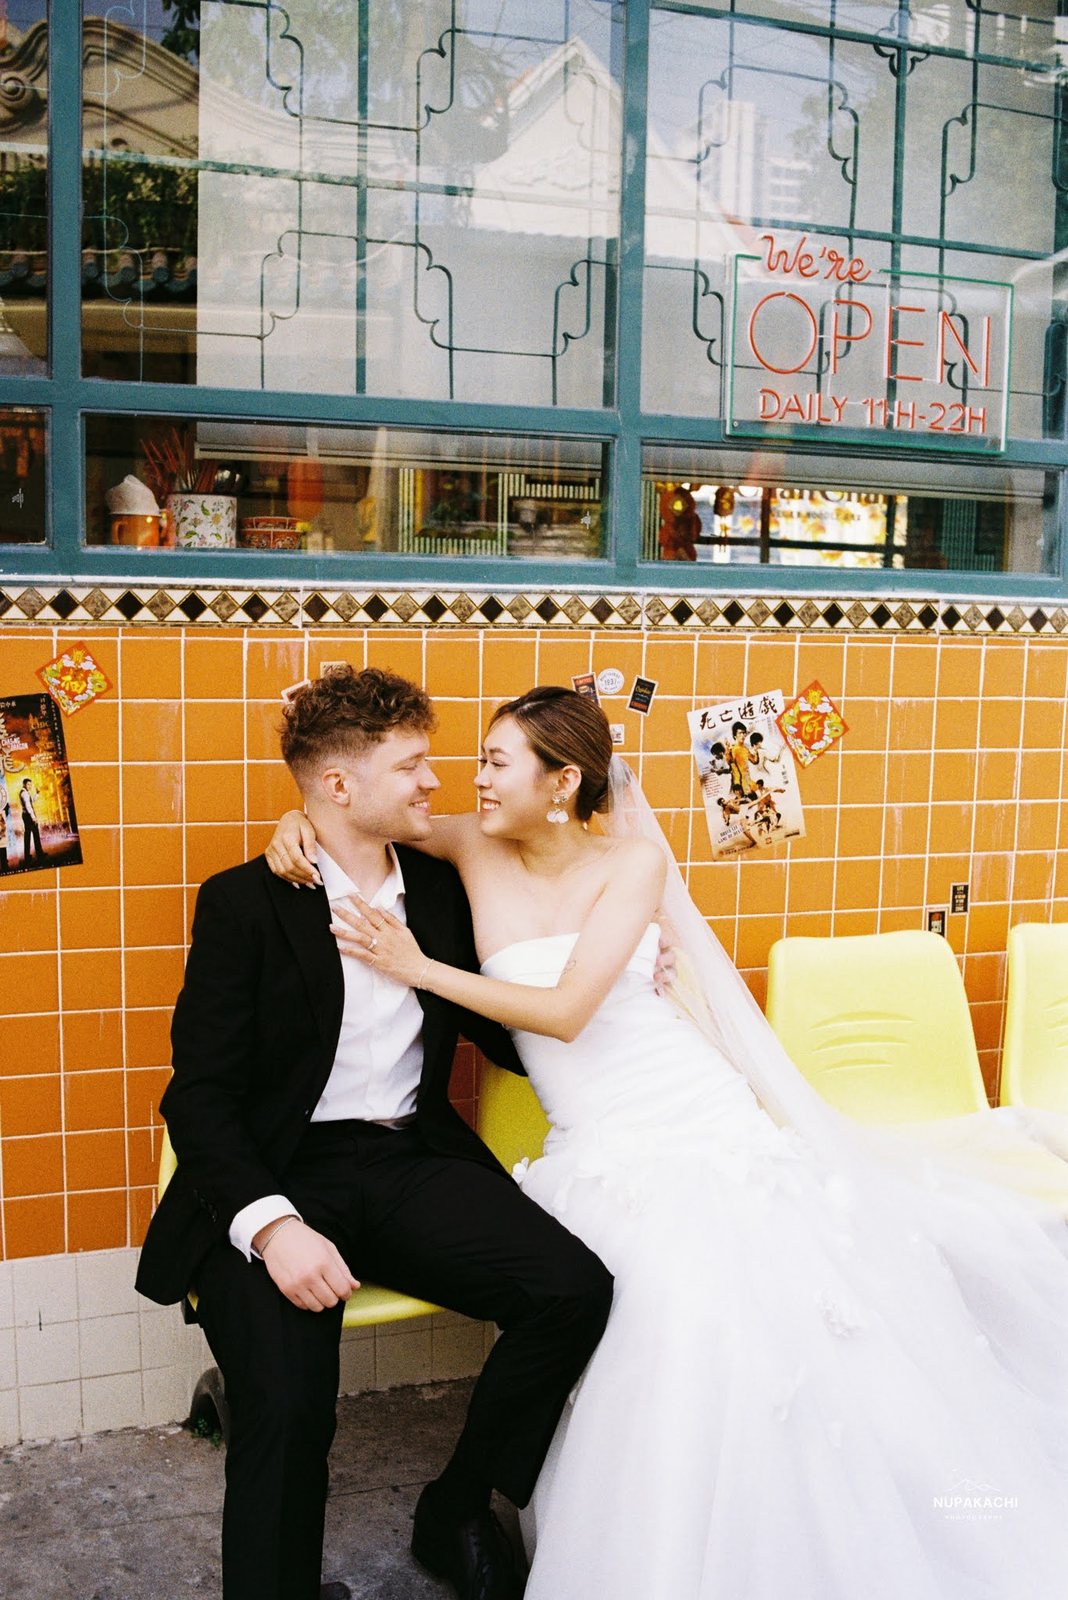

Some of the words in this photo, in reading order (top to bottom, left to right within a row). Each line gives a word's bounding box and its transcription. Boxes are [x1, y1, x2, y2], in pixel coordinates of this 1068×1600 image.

[760, 235, 872, 282] We're
[749, 291, 991, 387] OPEN
[759, 388, 848, 423] DAILY
[862, 397, 987, 434] 11H-22H
